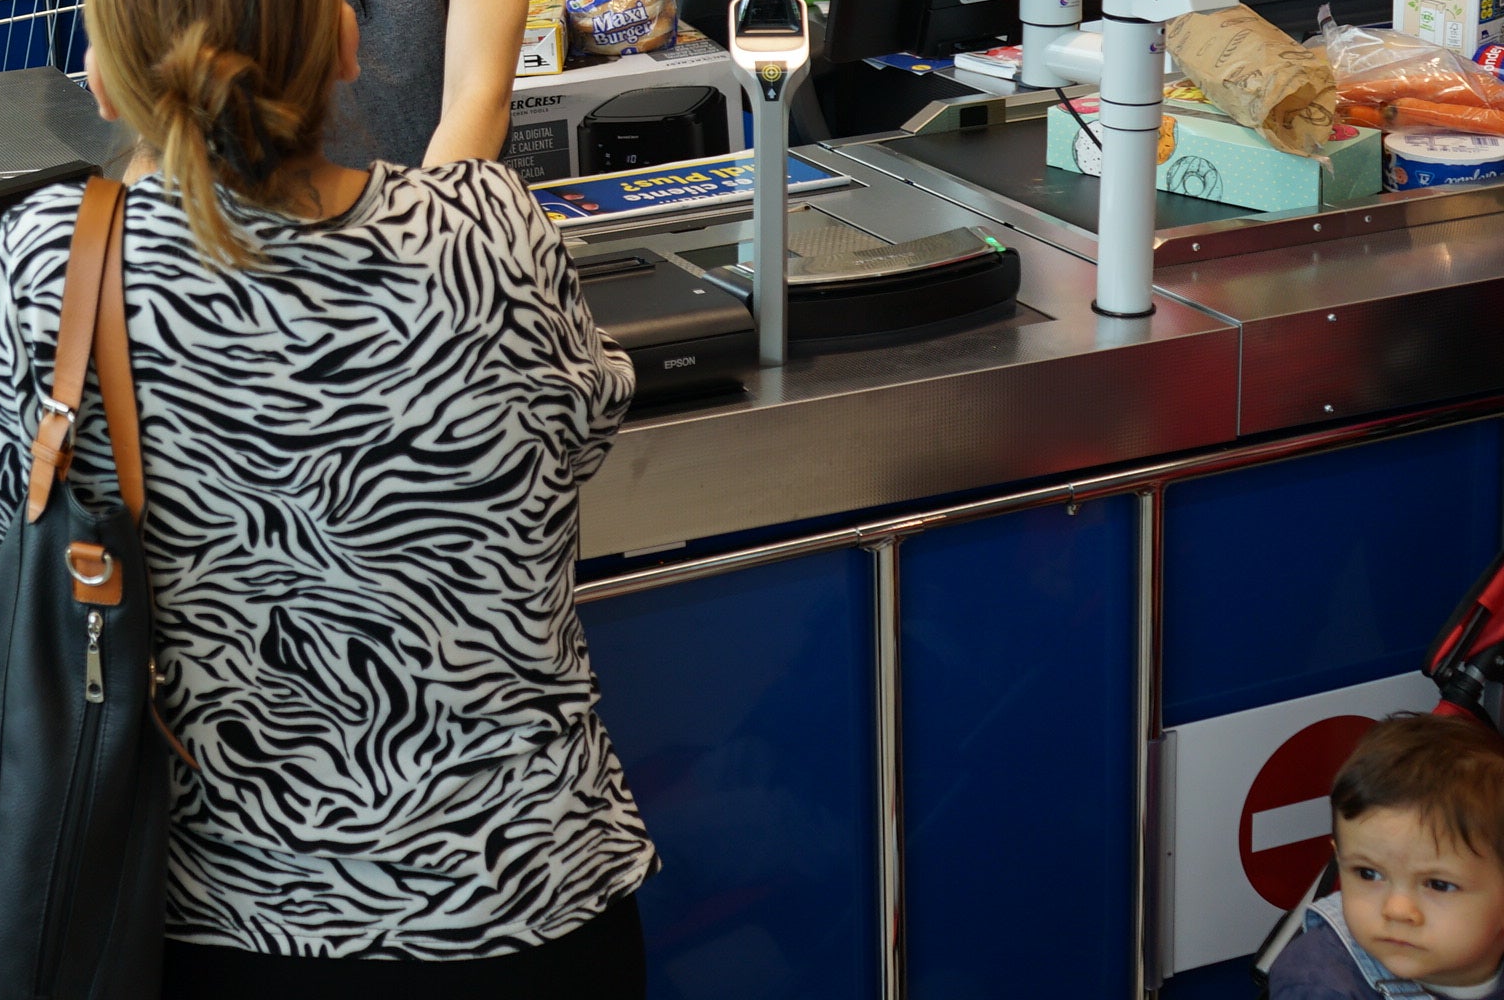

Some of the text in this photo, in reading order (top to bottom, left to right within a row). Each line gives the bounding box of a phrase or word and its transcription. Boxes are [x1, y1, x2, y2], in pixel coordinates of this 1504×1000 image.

[592, 0, 649, 34] Maxi
[594, 21, 653, 45] Burger
[510, 95, 563, 111] ERCREST
[525, 127, 554, 140] DIGITAL
[519, 139, 554, 153] CALIENTE
[521, 166, 545, 178] CALDA
[620, 172, 713, 192] Plus?
[623, 182, 719, 201] cliente
[664, 356, 696, 370] EPSON
